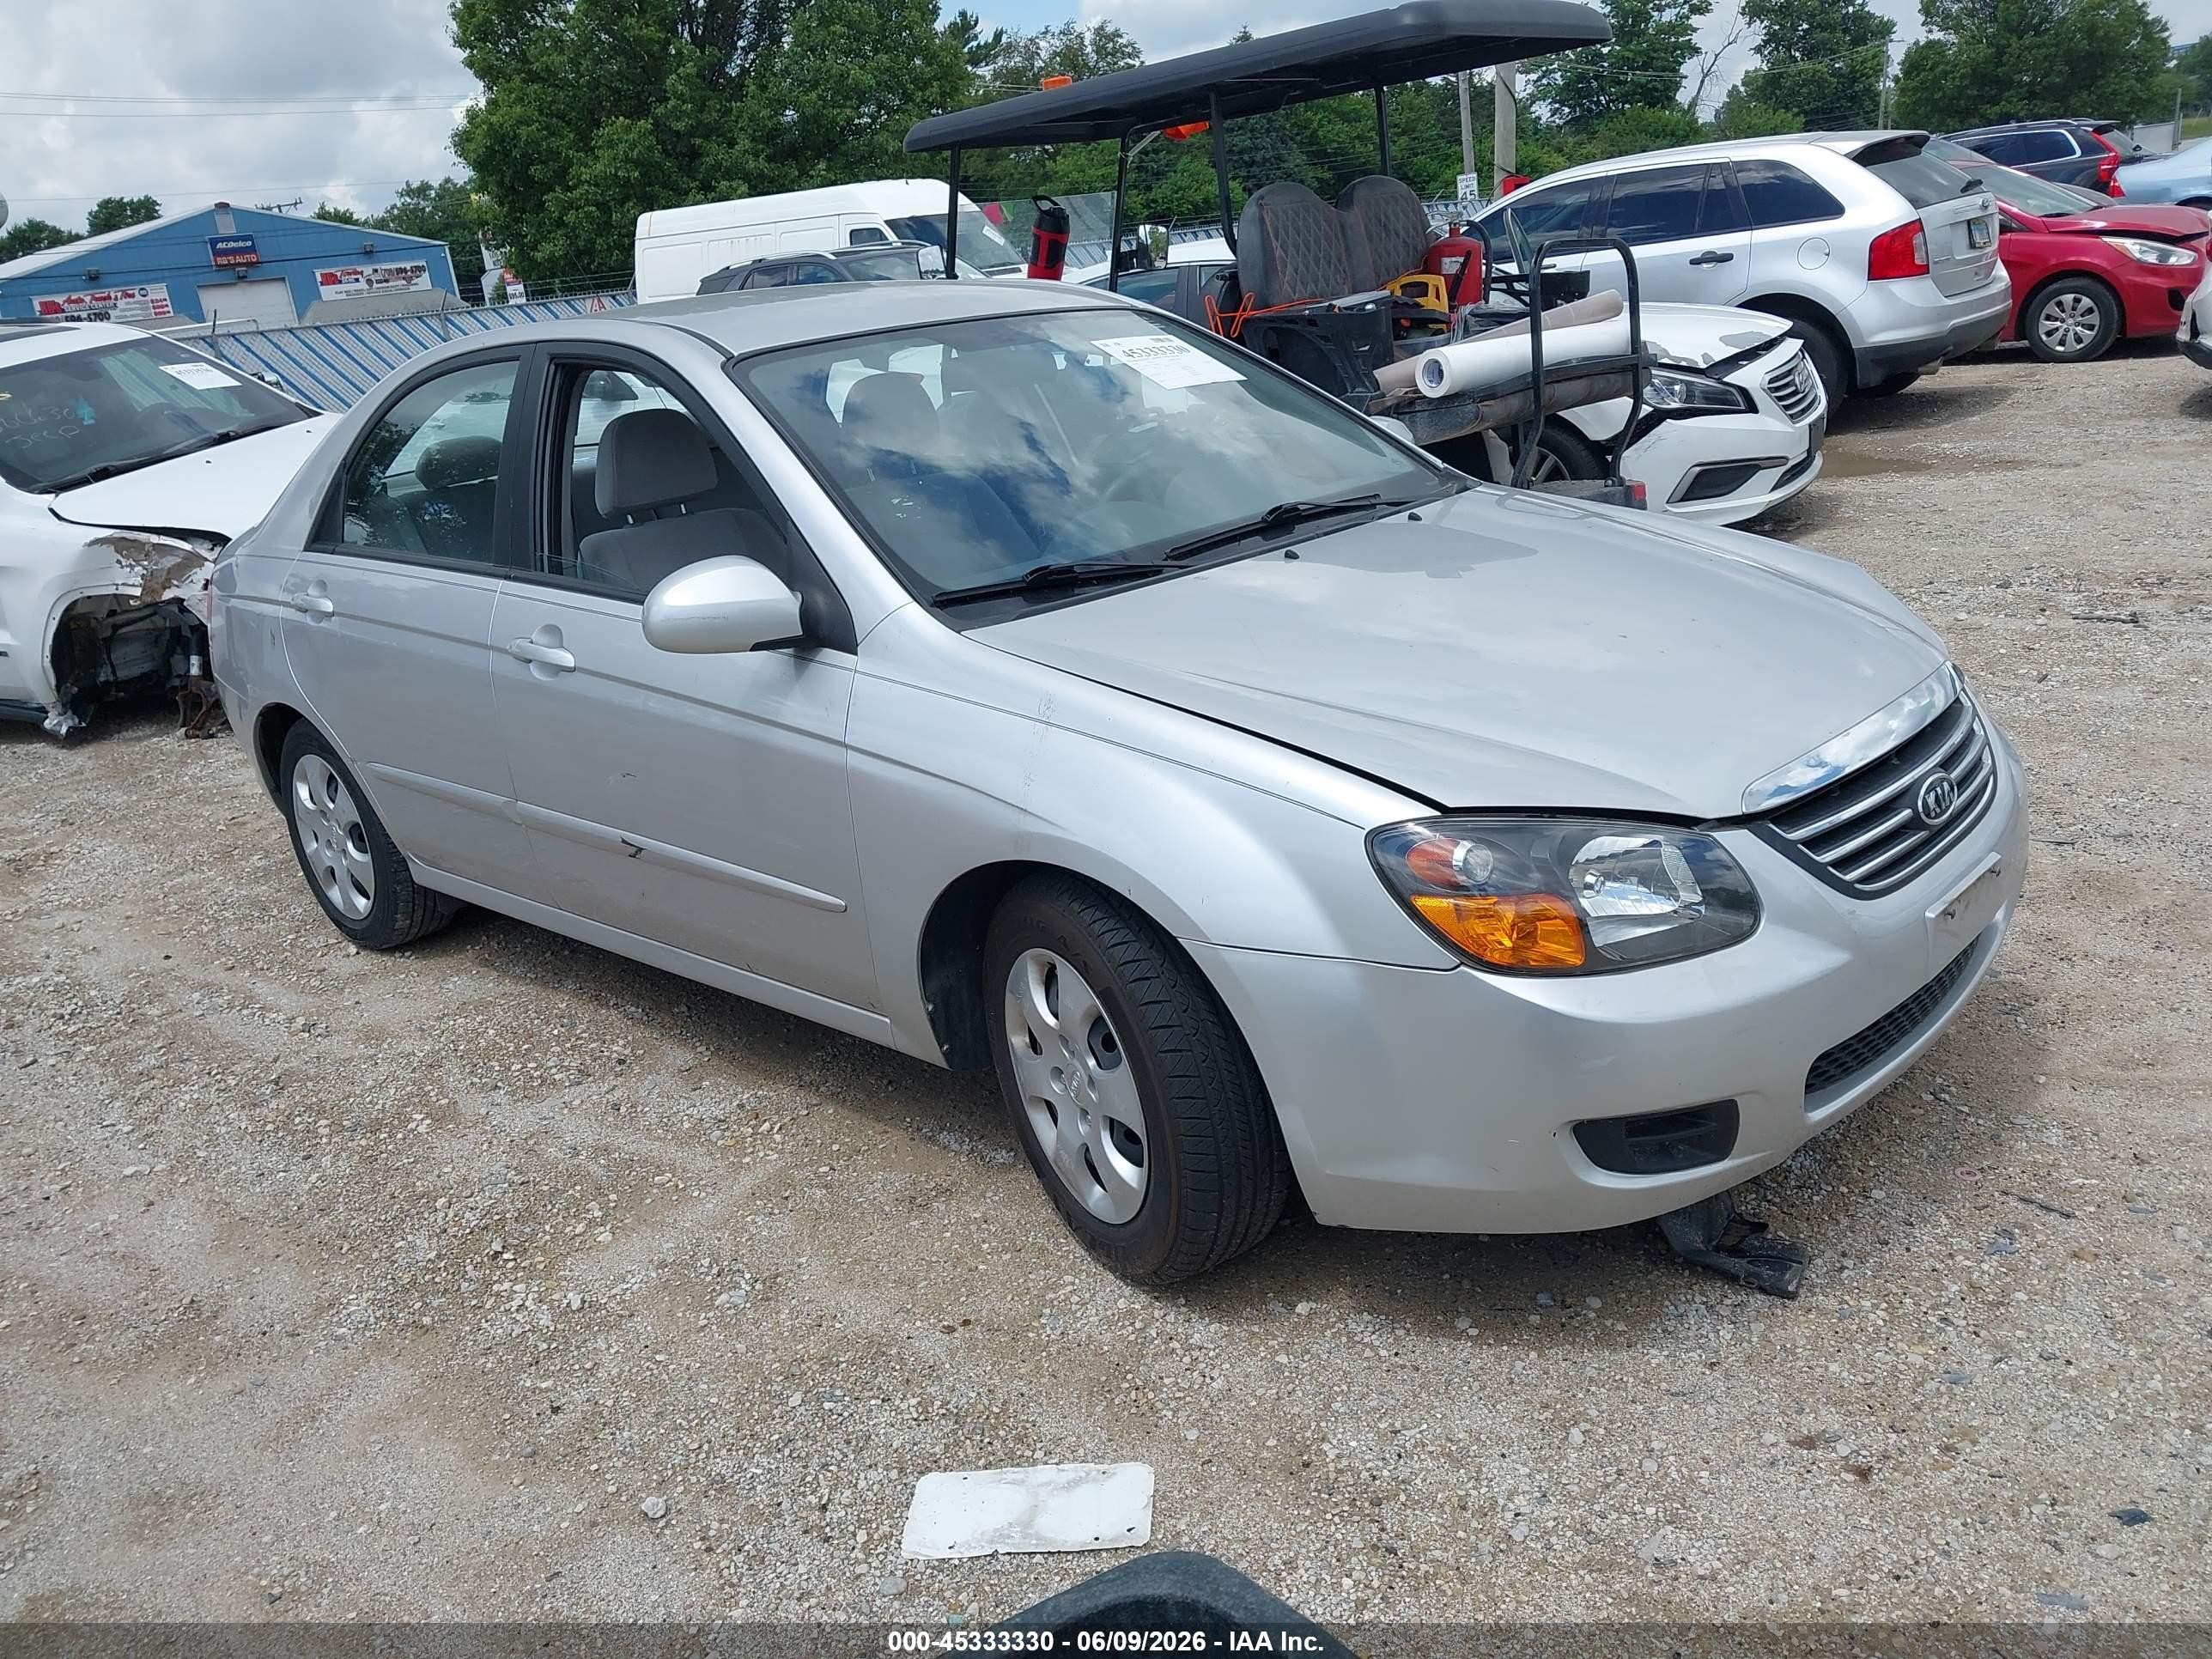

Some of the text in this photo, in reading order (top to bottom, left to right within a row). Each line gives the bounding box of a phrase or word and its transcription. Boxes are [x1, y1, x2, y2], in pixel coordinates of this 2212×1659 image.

[1461, 190, 1476, 200] 45
[236, 254, 257, 263] AUTO
[1121, 344, 1191, 360] 45333330
[1923, 781, 1955, 818] KIA
